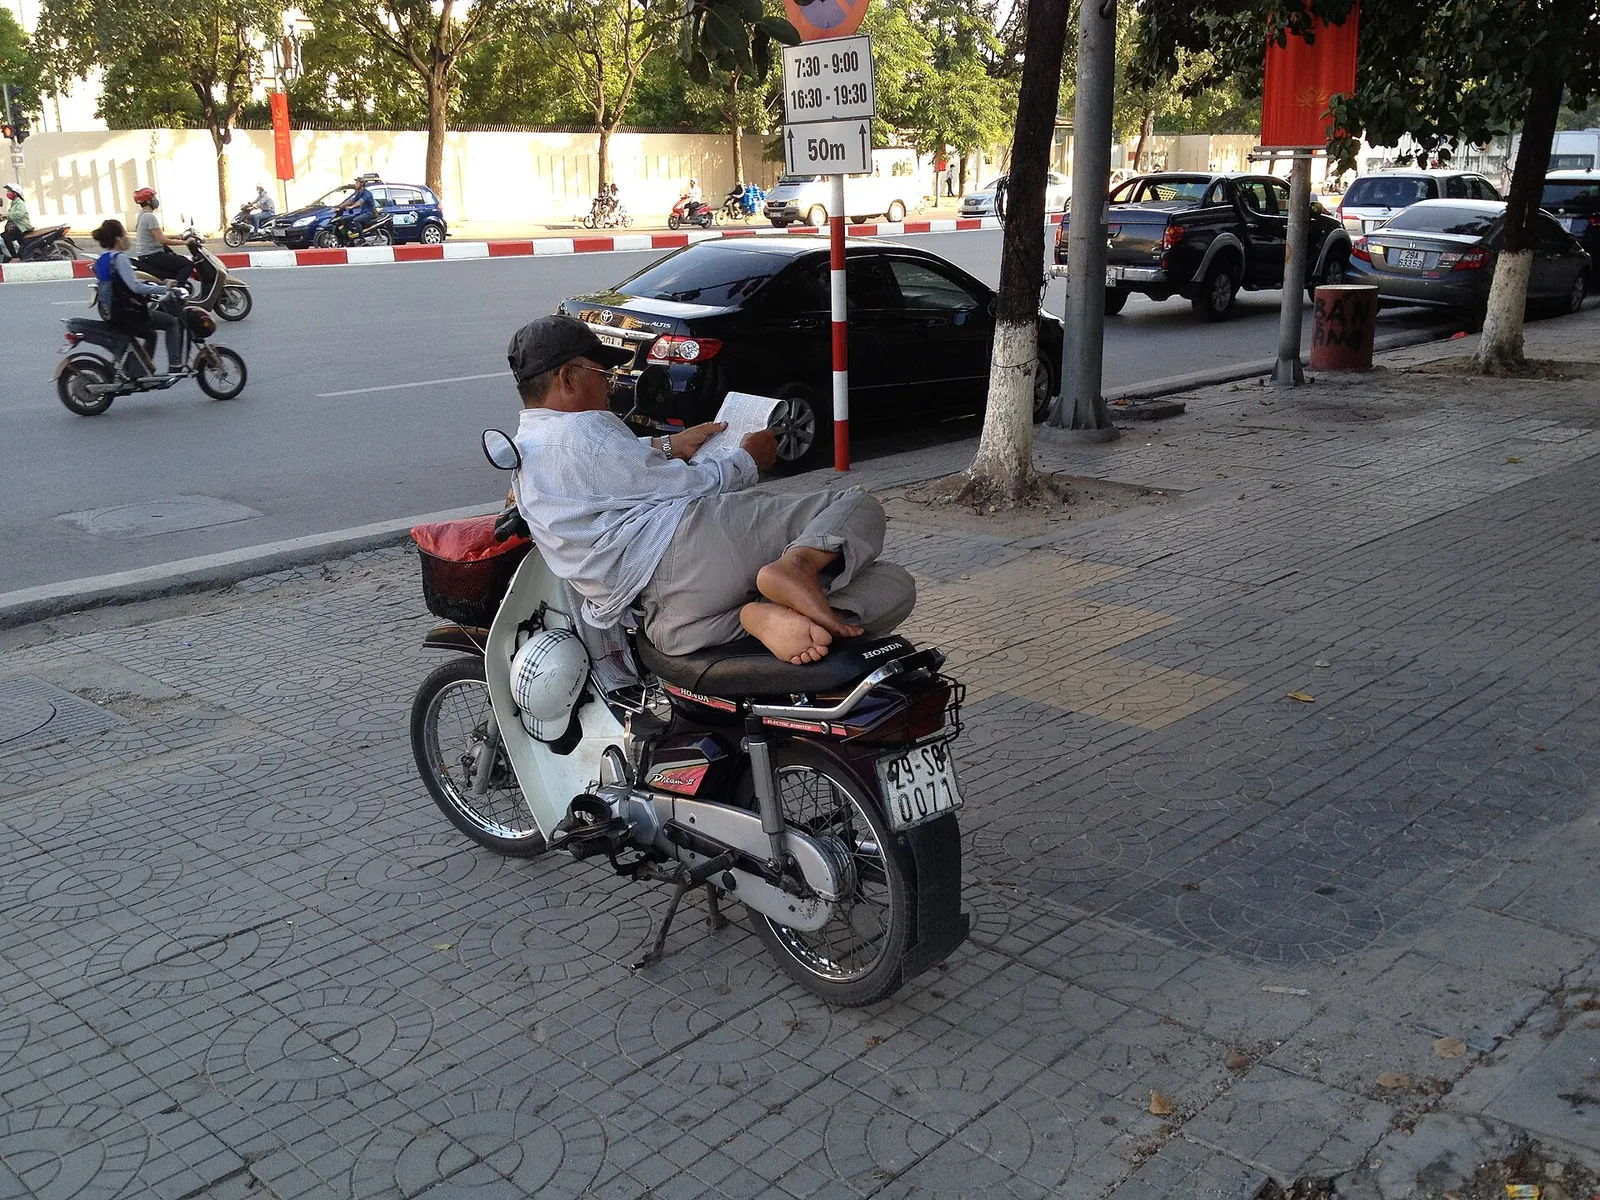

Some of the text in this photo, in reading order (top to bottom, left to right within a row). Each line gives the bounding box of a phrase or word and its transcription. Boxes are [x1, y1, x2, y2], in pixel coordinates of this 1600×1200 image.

[795, 56, 820, 78] 7:30
[831, 51, 859, 74] 9:00
[791, 87, 822, 110] 16:30
[833, 82, 867, 105] 19:30
[807, 138, 845, 161] 50m
[862, 642, 903, 660] HONDA
[680, 687, 710, 703] HONDA
[767, 719, 789, 727] ELECTRIC
[652, 773, 684, 785] Dream
[898, 777, 954, 821] 0071
